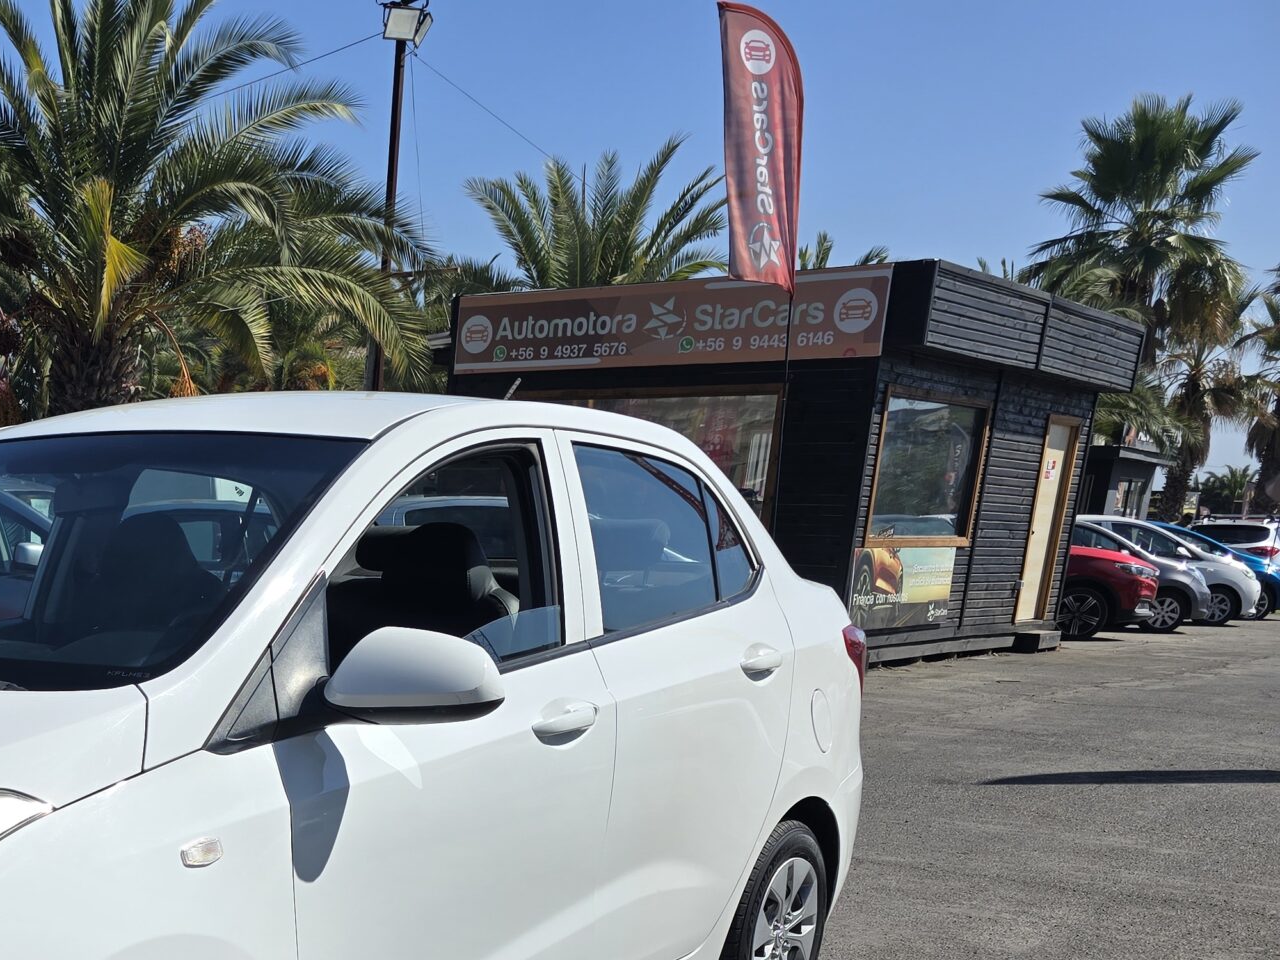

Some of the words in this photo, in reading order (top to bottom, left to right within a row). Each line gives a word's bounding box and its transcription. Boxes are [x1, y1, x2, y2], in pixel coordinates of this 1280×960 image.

[693, 299, 825, 331] StarCars
[495, 311, 637, 340] Automotora
[510, 347, 534, 360] +56
[540, 346, 549, 359] 9
[554, 344, 587, 358] 4937
[593, 341, 627, 356] 5676
[696, 337, 725, 351] +56
[732, 336, 742, 350] 9
[750, 334, 788, 350] 9443
[797, 331, 834, 347] 6146
[876, 593, 886, 604] con
